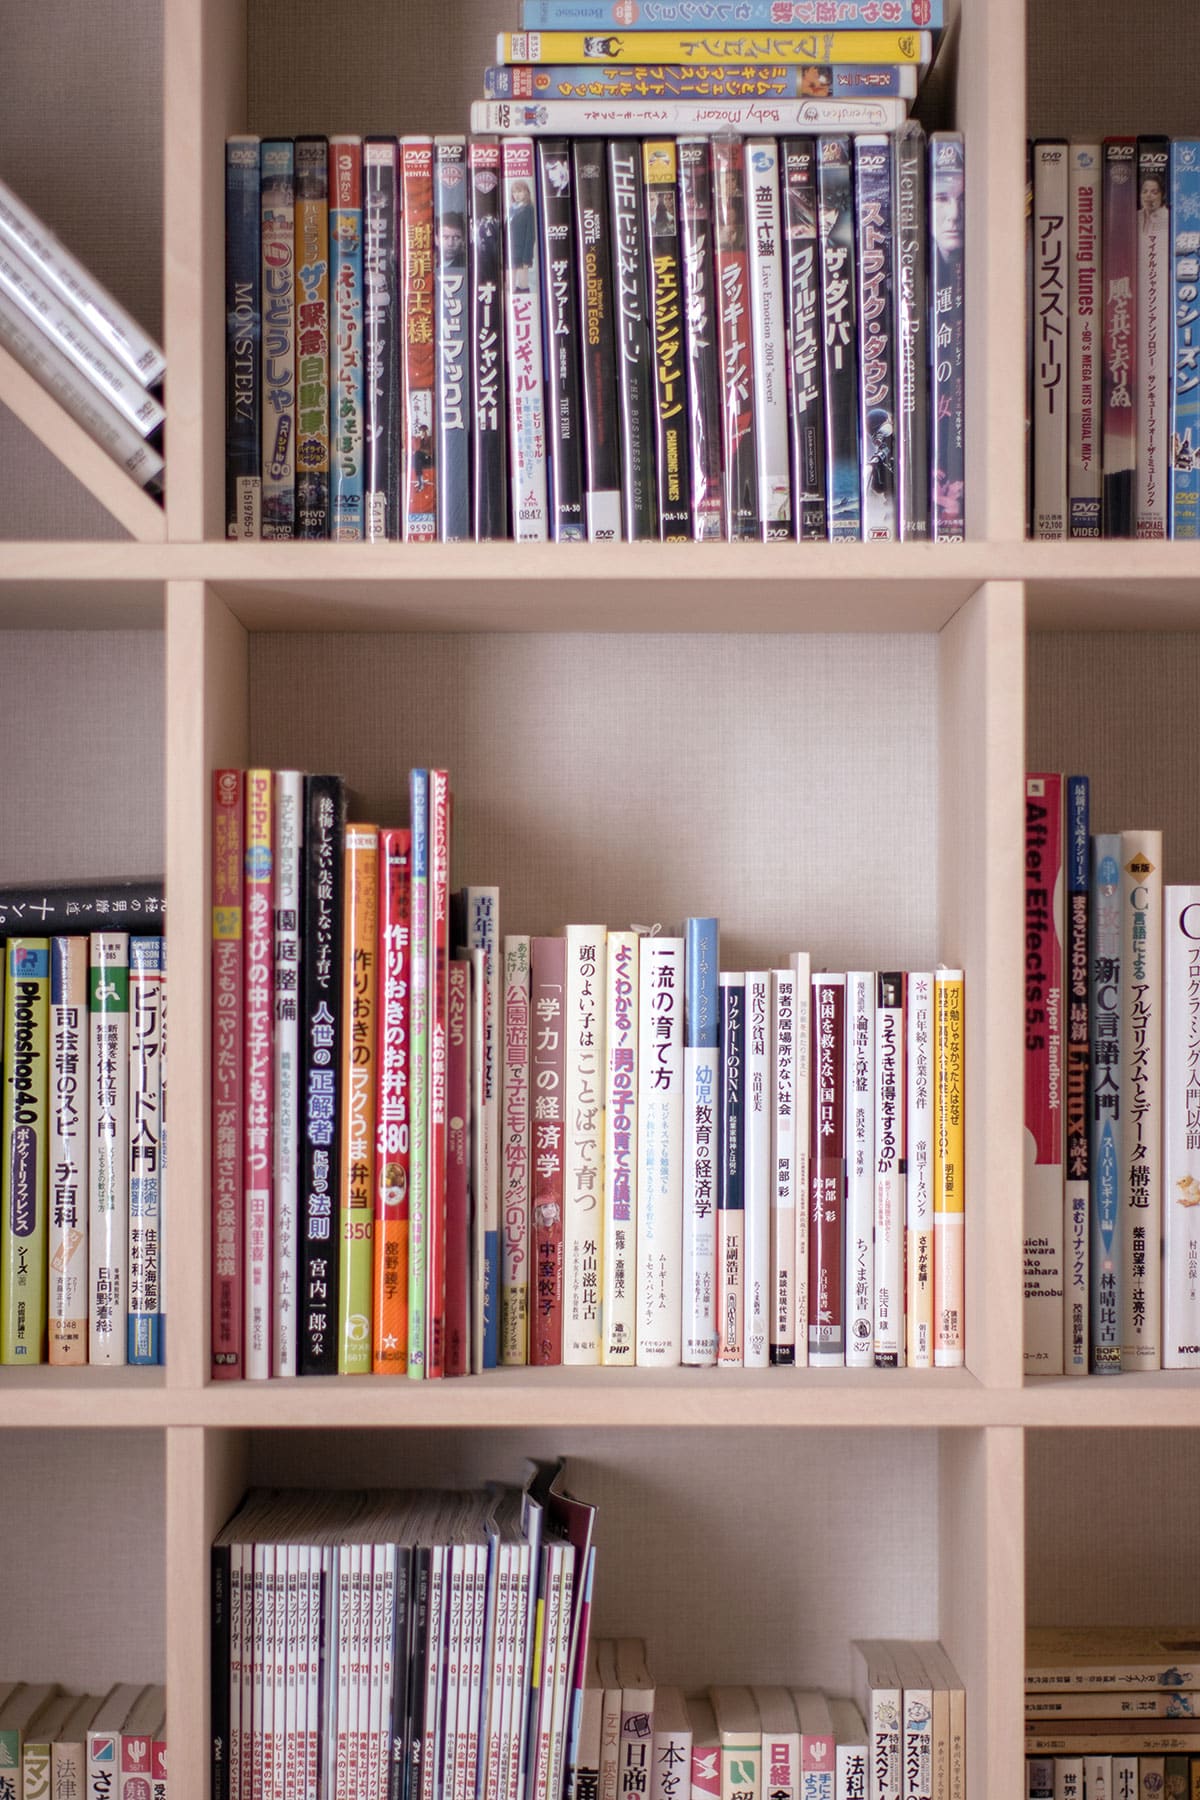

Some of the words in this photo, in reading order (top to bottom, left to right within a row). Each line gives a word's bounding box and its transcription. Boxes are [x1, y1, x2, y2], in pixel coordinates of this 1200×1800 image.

[555, 8, 604, 20] Benesse
[679, 33, 818, 59] マレフィセント
[771, 2, 903, 25] おやこ遊び歌
[696, 109, 743, 123] Mozart
[746, 104, 781, 122] Baby
[405, 151, 431, 161] DVD
[438, 145, 462, 155] DVD
[472, 149, 498, 159] DVD
[504, 149, 530, 159] DVD
[787, 155, 810, 164] DVD
[1108, 146, 1135, 156] DVD
[1140, 153, 1168, 163] DVD
[584, 209, 595, 244] NOTE
[755, 185, 775, 257] 相川七瀬
[901, 158, 918, 230] Mental
[1076, 186, 1096, 262] amazing
[408, 223, 433, 344] 謝罪の王様
[552, 260, 571, 336] ザ・ファーム
[586, 253, 598, 305] GOLDEN
[762, 265, 771, 287] Live
[825, 247, 849, 369] ザ・ダイバー
[862, 203, 889, 406] ストライク・ダウン
[902, 239, 919, 307] Secret
[1078, 268, 1096, 316] tunes
[265, 269, 292, 413] じどうしゃ
[511, 298, 537, 392] ビリギャル
[588, 308, 600, 345] EGGS
[653, 255, 684, 421] チェンジング・レーン
[763, 291, 772, 339] Emotion
[791, 246, 818, 413] ワイルドスピード
[1039, 215, 1064, 414] アリスストーリー
[1107, 276, 1132, 408] 風と共に去りぬ
[1174, 231, 1200, 395] 銀色のシーズン
[438, 275, 464, 430] マッドマックス
[478, 283, 498, 431] オーシャンズ11
[903, 319, 920, 412] Program
[936, 286, 953, 419] 運命の女
[1081, 355, 1092, 383] MEGA
[560, 397, 568, 416] THE
[630, 378, 638, 401] THE
[1081, 383, 1092, 406] HITS
[1081, 407, 1092, 441] VISUAL
[561, 417, 570, 439] FIRM
[631, 409, 641, 472] BUSINESS
[667, 429, 679, 473] CHANGING
[300, 510, 325, 519] PHVD
[668, 474, 680, 501] LANES
[1072, 502, 1099, 512] DVD
[1073, 527, 1100, 537] VIDEO
[1137, 520, 1164, 530] MICHAEL
[251, 778, 268, 840] PriPri
[1025, 803, 1048, 882] After
[1074, 784, 1086, 886] 最新PC読本シリーズ
[317, 797, 334, 988] 後悔しない失敗しない子育て
[1130, 863, 1151, 873] 新版
[275, 908, 297, 1021] 園庭整備
[1025, 888, 1048, 1002] Effects
[1071, 895, 1087, 997] まるごとわかる
[1130, 886, 1150, 981] C言語による
[247, 892, 270, 1170] あそびの中で子どもは育つ
[450, 968, 467, 1046] おべんとう
[654, 950, 676, 1090] 一流の育て方
[752, 983, 766, 1056] 現代の貧困
[1024, 1006, 1046, 1052] 5.5
[1048, 987, 1060, 1030] Hyper
[1070, 1002, 1087, 1041] 最新
[1094, 957, 1121, 1121] 新C言語入門
[131, 986, 160, 1172] ビリヤード入門
[349, 949, 372, 1209] 作りおきのラクうま弁当
[535, 984, 562, 1178] 「学力」の経済学
[574, 945, 599, 1212] 頭のよい子はことばで育つ
[611, 944, 634, 1222] よくわかる！男の子の育て方講座
[727, 995, 740, 1103] リクルートのDNA
[778, 983, 793, 1116] 弱者の居場所がない社会
[855, 1015, 869, 1092] 論語と算盤
[915, 1008, 928, 1110] 百年続く企業の条件
[949, 988, 960, 1126] ガリ勉じゃなかった人はなぜ
[1047, 1034, 1060, 1109] Handbook
[54, 1006, 79, 1229] 司会者のスピーチ百科
[308, 1001, 335, 1240] 人世の正解者に育つ法則
[752, 1072, 763, 1112] 岩田正美
[878, 1014, 898, 1173] うそつきは得をするのか
[1128, 984, 1152, 1208] アルゴリズムとデータ構造
[695, 1065, 713, 1219] 幼児教育の経済学
[15, 1128, 30, 1231] ポケットリファレンス
[915, 1140, 929, 1218] 帝国データバンク
[1101, 1136, 1113, 1231] スーパービギナー編
[343, 1222, 373, 1240] 350
[726, 1235, 738, 1286] 江副浩正
[919, 1235, 929, 1290] さすが老舗！
[1072, 1198, 1086, 1292] 読むリナックス。
[1188, 1240, 1198, 1280] 村山公保
[308, 1258, 329, 1355] 宮内一郎の本
[538, 1242, 556, 1316] 中室牧子
[582, 1239, 597, 1321] 外山滋比古
[659, 1254, 667, 1309] ムーギー・キム
[778, 1270, 788, 1332] 講談社現代新書
[855, 1238, 869, 1311] ちくま新書
[1099, 1273, 1117, 1343] 林晴比古
[609, 1345, 630, 1354] PHP
[852, 1342, 871, 1352] 827
[1072, 1304, 1083, 1356] 技術評論社
[1095, 1347, 1120, 1356] SOFT
[231, 1571, 240, 1650] 日経トップリーダー
[276, 1574, 284, 1653] 日経トップリーダー
[310, 1572, 320, 1651] 日経トップリーダー
[351, 1572, 360, 1652] 日経トップリーダー
[384, 1571, 393, 1650] 日経トップリーダー
[431, 1573, 441, 1653] 日経トップリーダー
[497, 1573, 508, 1652] 日経トップリーダー
[549, 1574, 561, 1653] 日経トップリーダー
[56, 1760, 77, 1800] 法律
[623, 1743, 647, 1793] 日商
[770, 1743, 790, 1786] 日経
[876, 1733, 889, 1792] アスペクト
[889, 1734, 898, 1754] 特集
[907, 1733, 920, 1792] アスペクト
[920, 1734, 930, 1754] 特集
[1064, 1773, 1077, 1797] 世界
[1120, 1768, 1134, 1799] 中小
